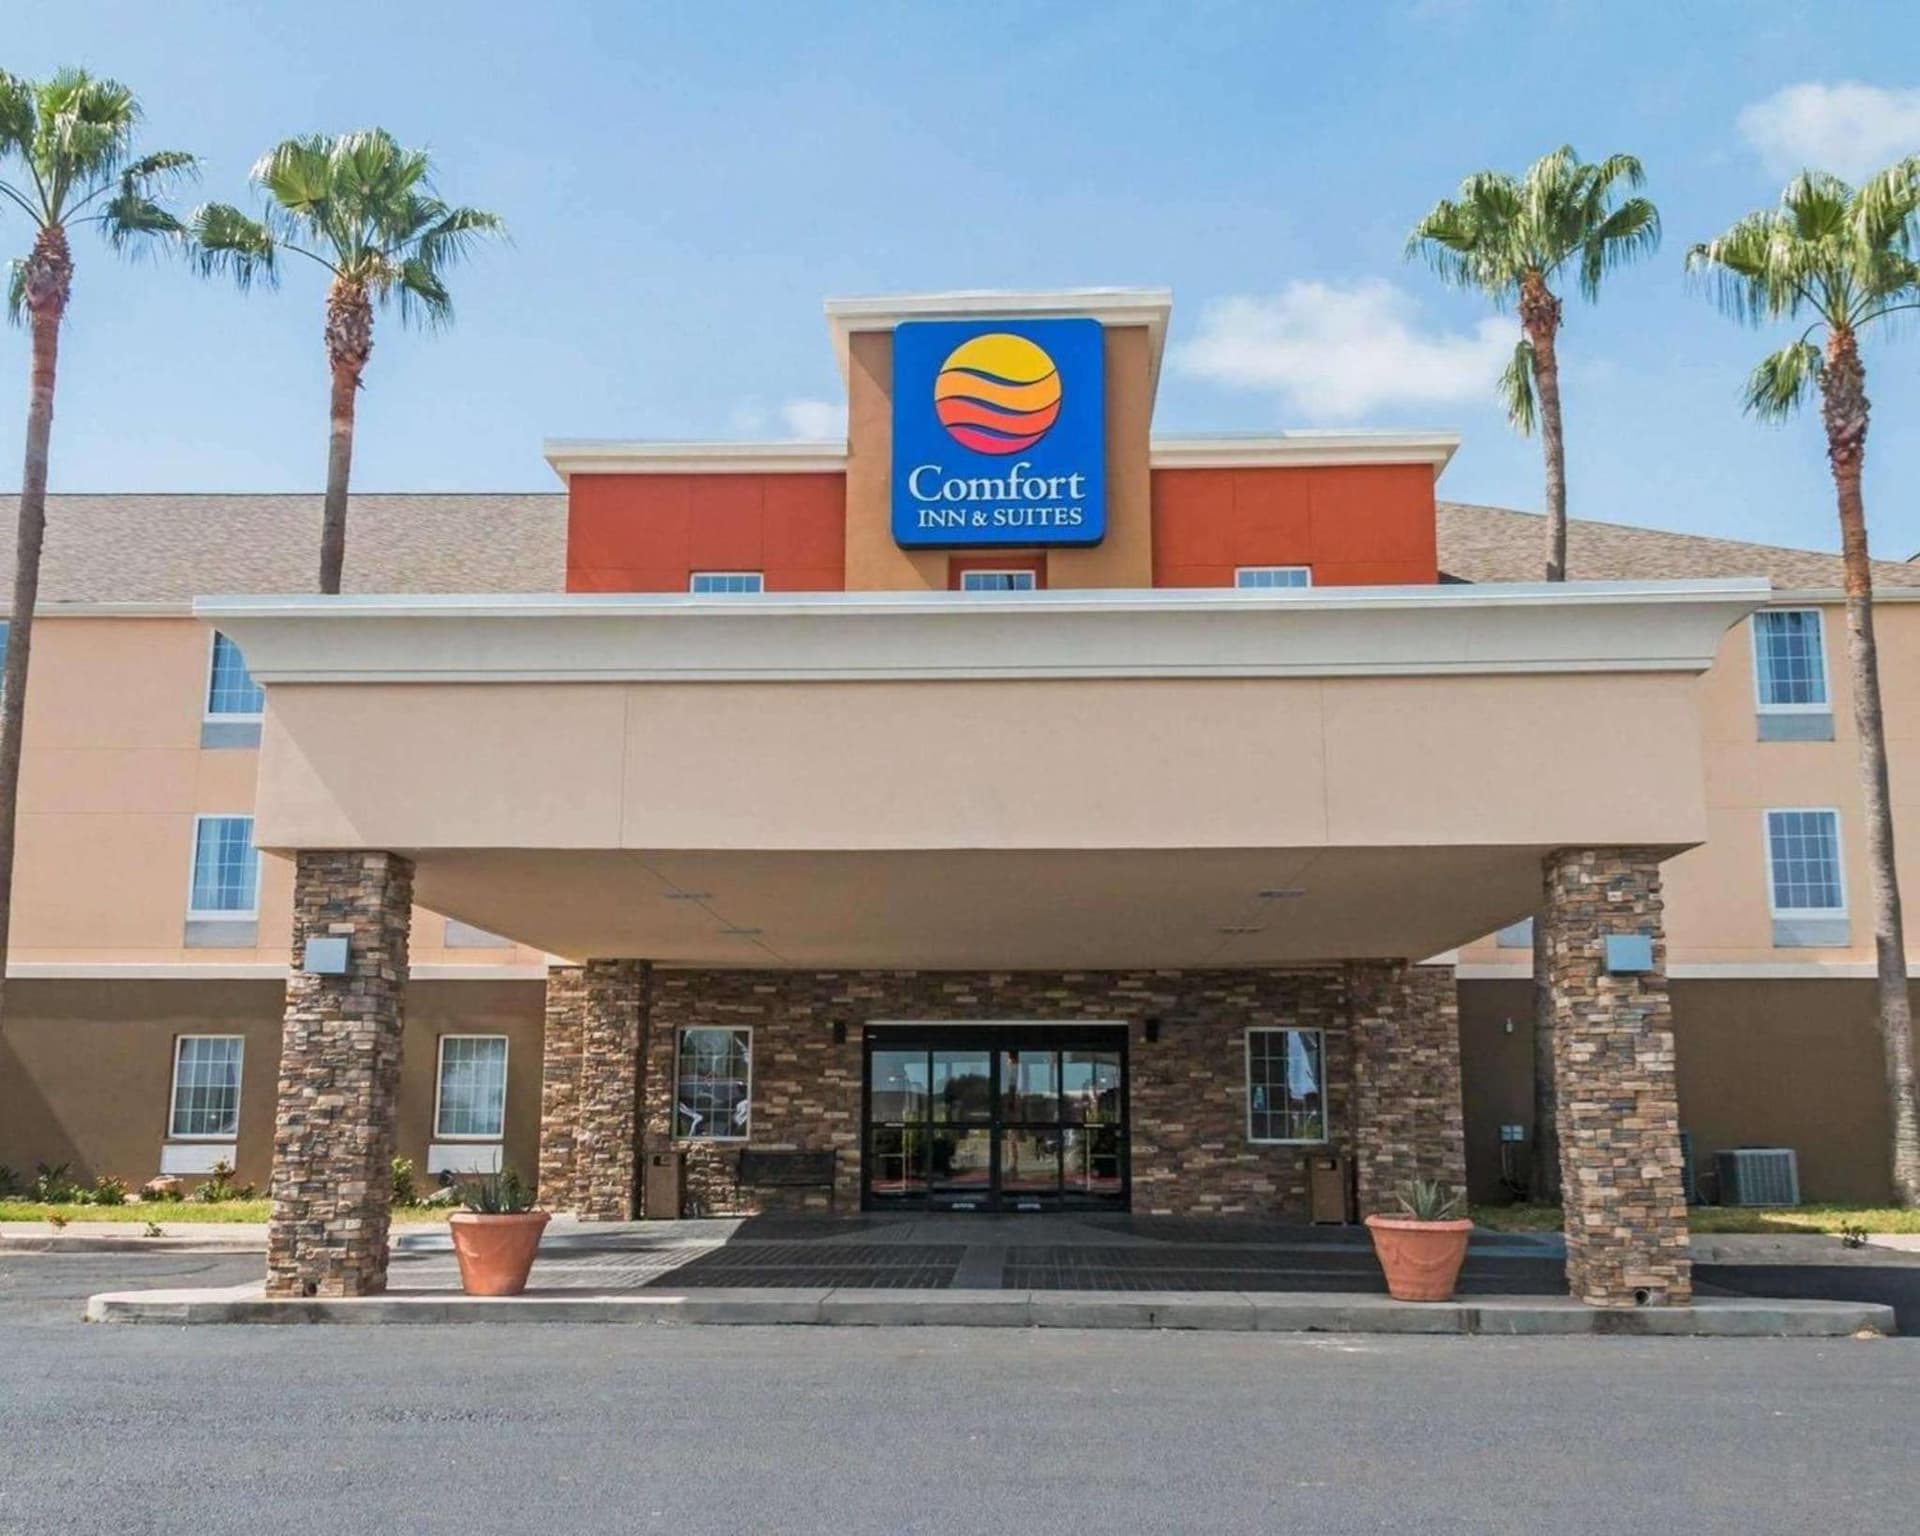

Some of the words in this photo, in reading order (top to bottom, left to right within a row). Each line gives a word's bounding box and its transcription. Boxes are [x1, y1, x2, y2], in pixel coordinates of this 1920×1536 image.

[908, 462, 1086, 501] Comfort
[917, 509, 967, 527] INN
[971, 511, 989, 527] &
[993, 507, 1082, 526] SUITES
